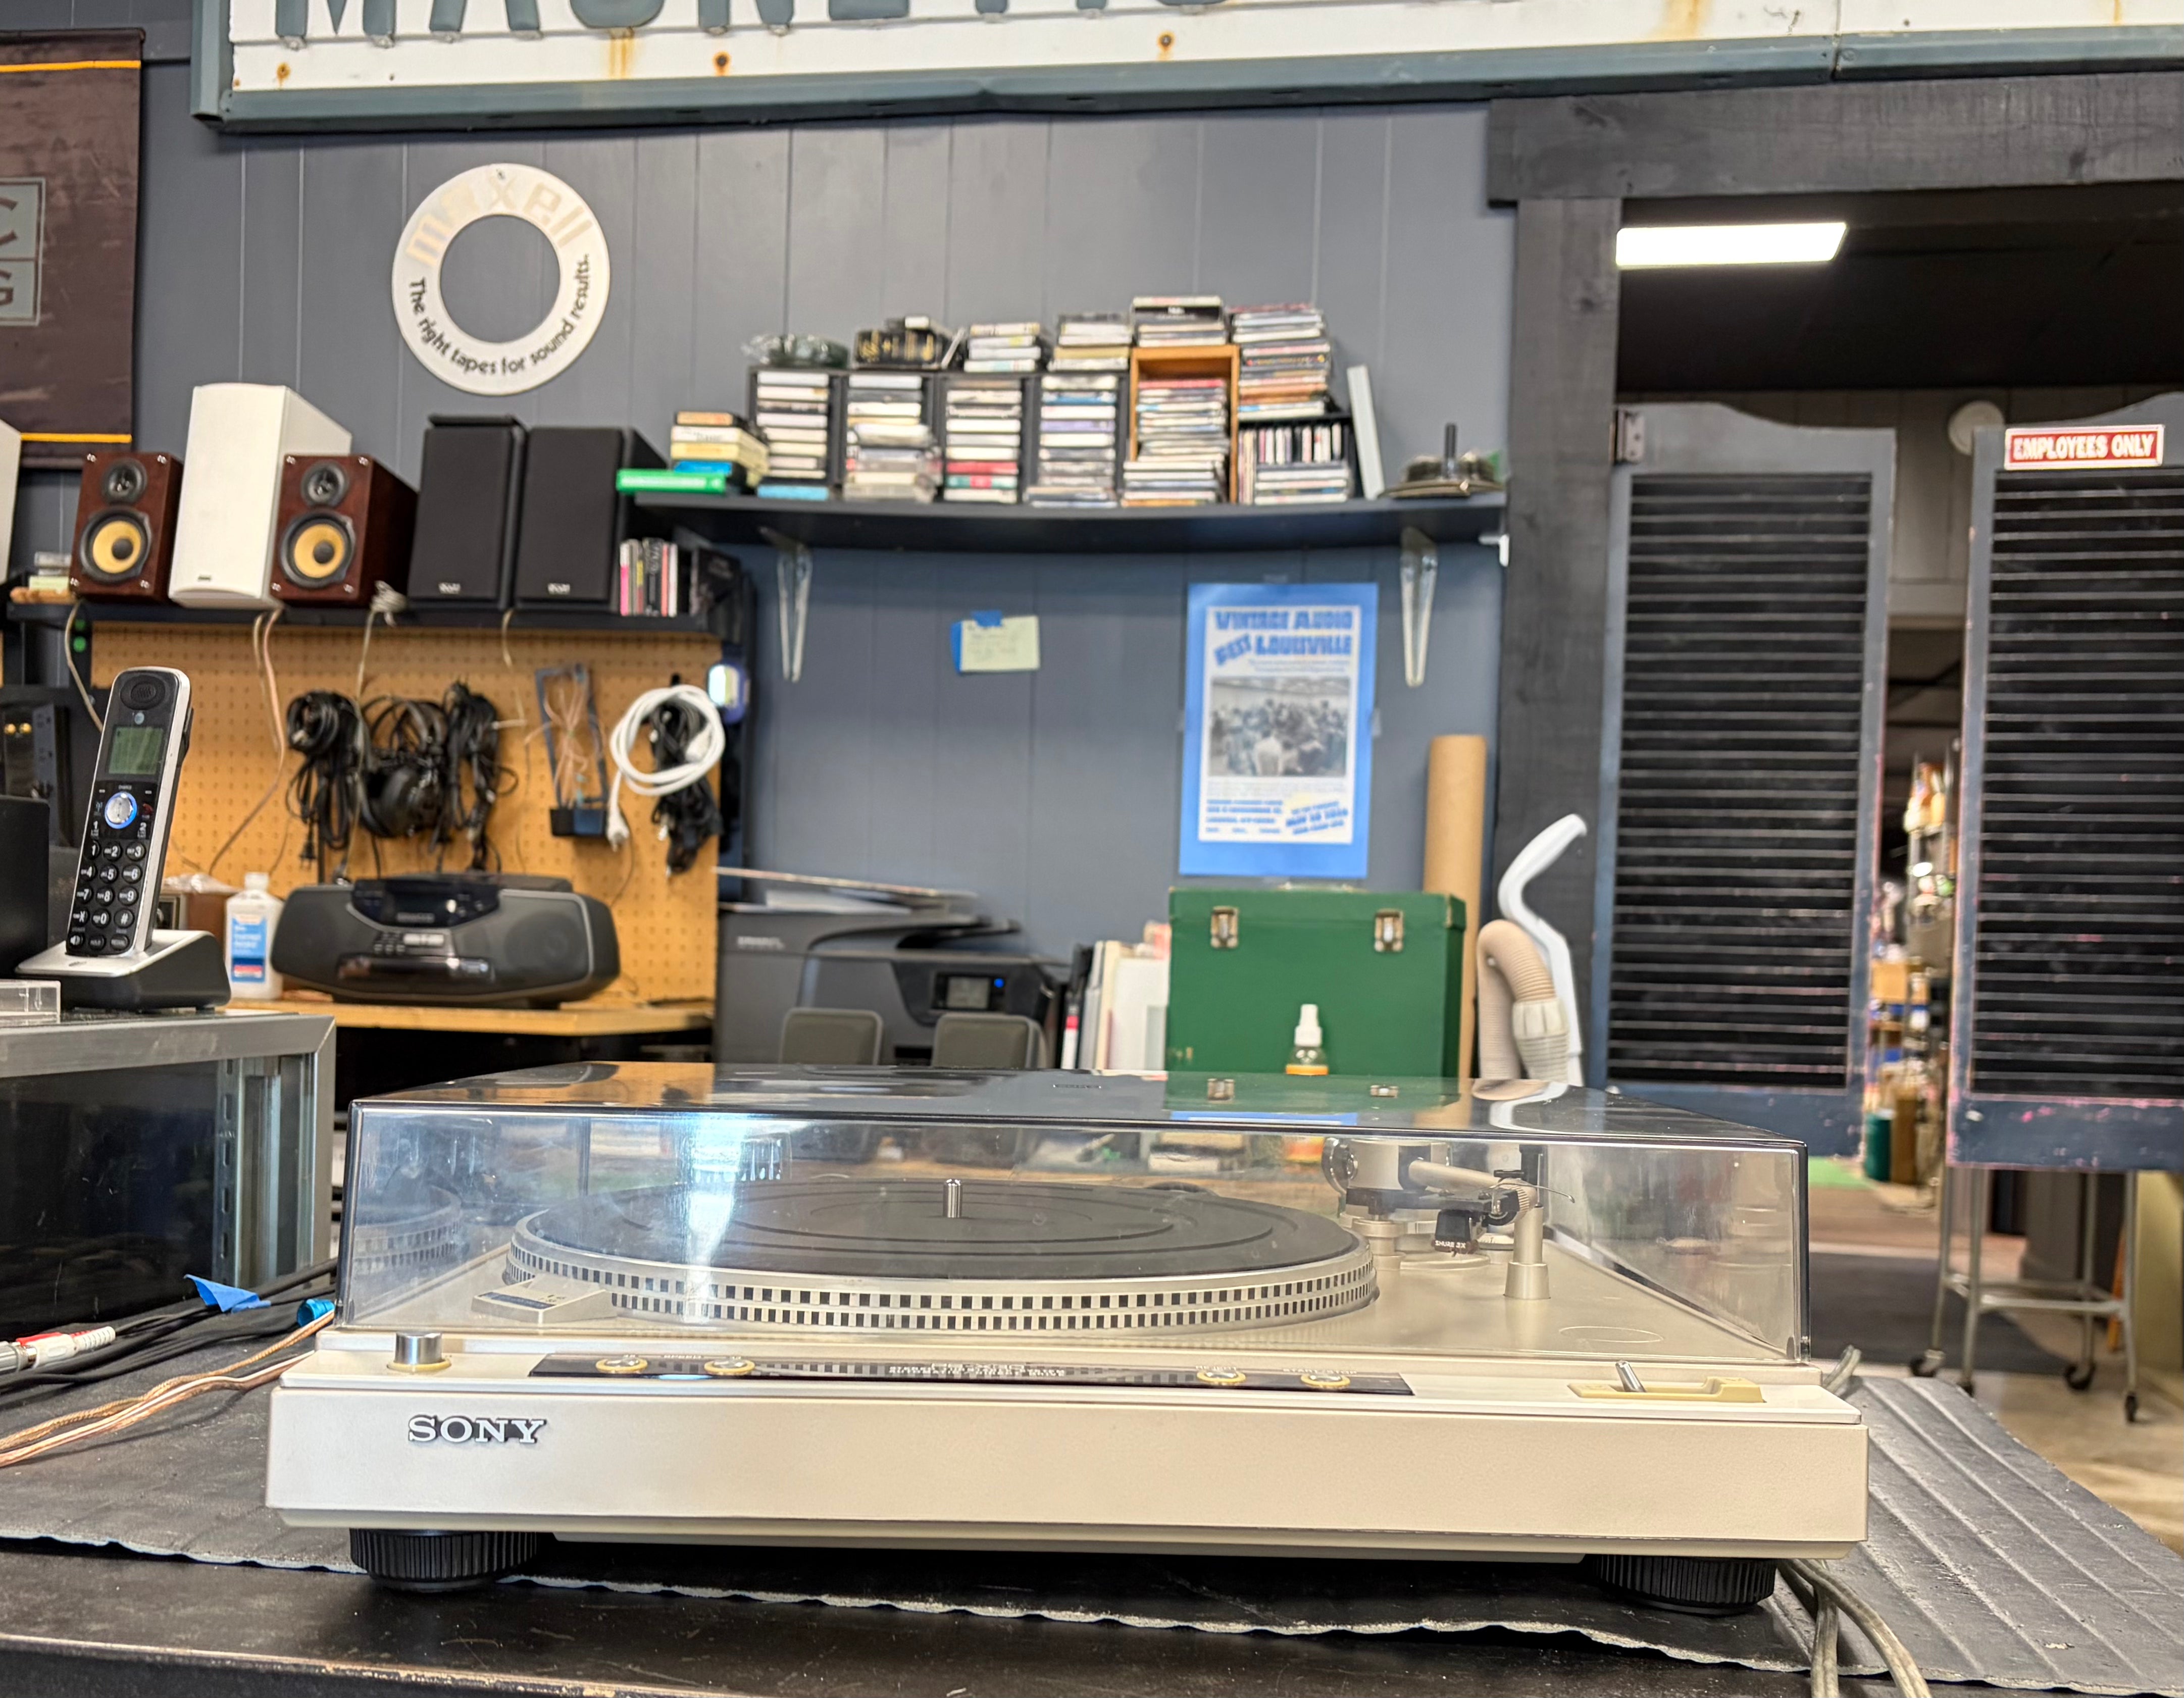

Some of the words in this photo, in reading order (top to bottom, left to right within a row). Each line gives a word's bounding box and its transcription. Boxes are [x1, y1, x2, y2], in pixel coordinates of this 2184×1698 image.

[409, 277, 427, 316] The
[418, 316, 451, 355] right
[451, 347, 496, 375] tapes
[2013, 435, 2109, 460] EMPLOYEES
[2111, 433, 2155, 457] ONLY
[408, 1414, 547, 1444] SONY
